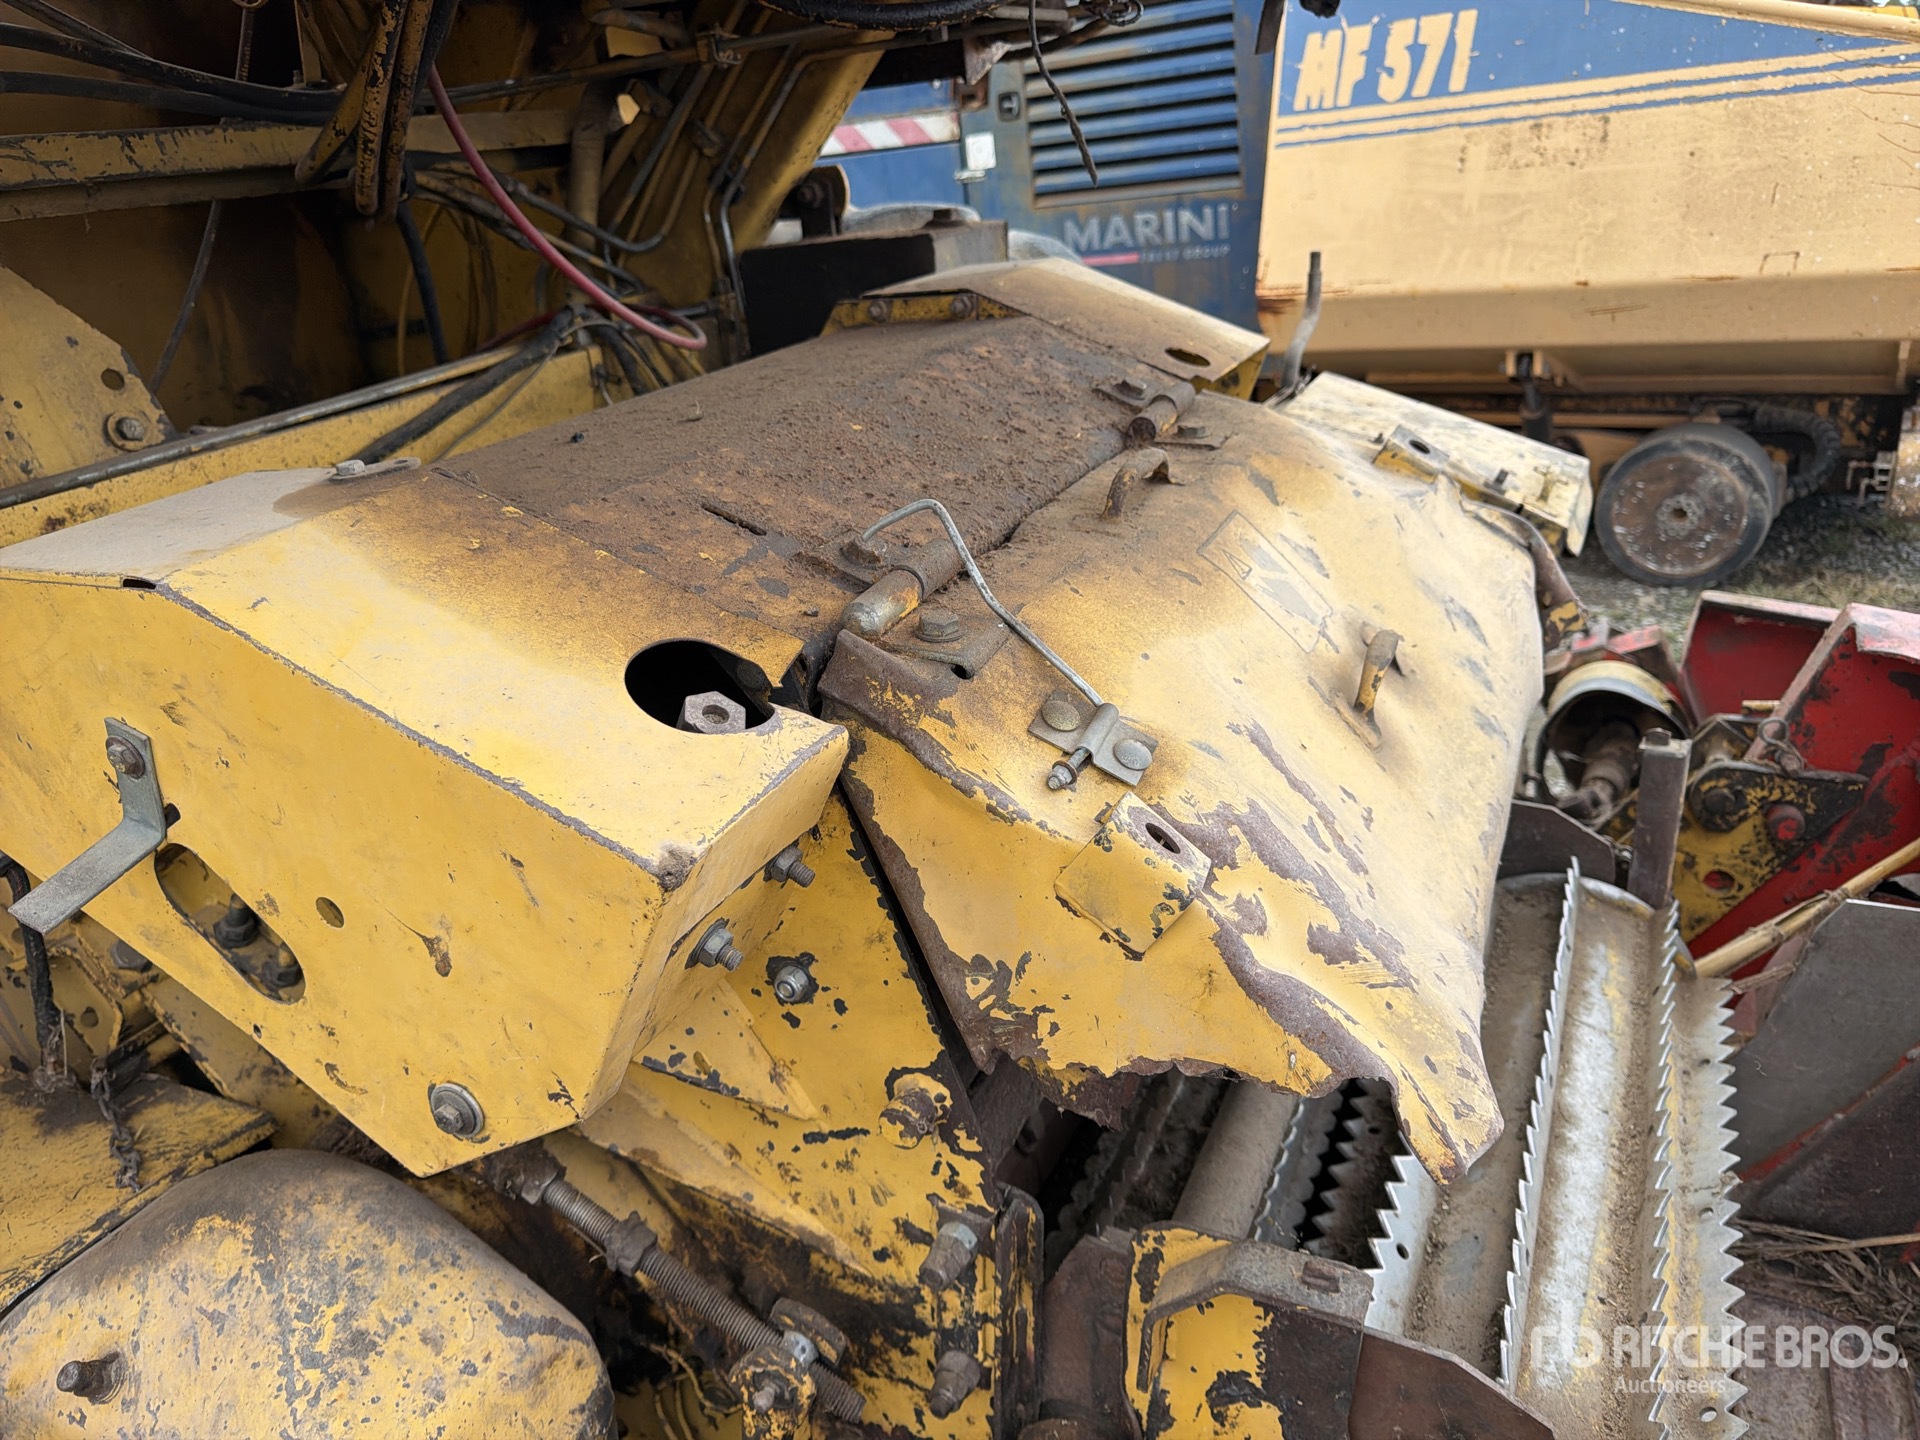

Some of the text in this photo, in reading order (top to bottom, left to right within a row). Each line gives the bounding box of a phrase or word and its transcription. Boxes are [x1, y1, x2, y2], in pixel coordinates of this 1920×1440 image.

[1293, 8, 1479, 111] MF 571
[1063, 202, 1231, 252] MARINI
